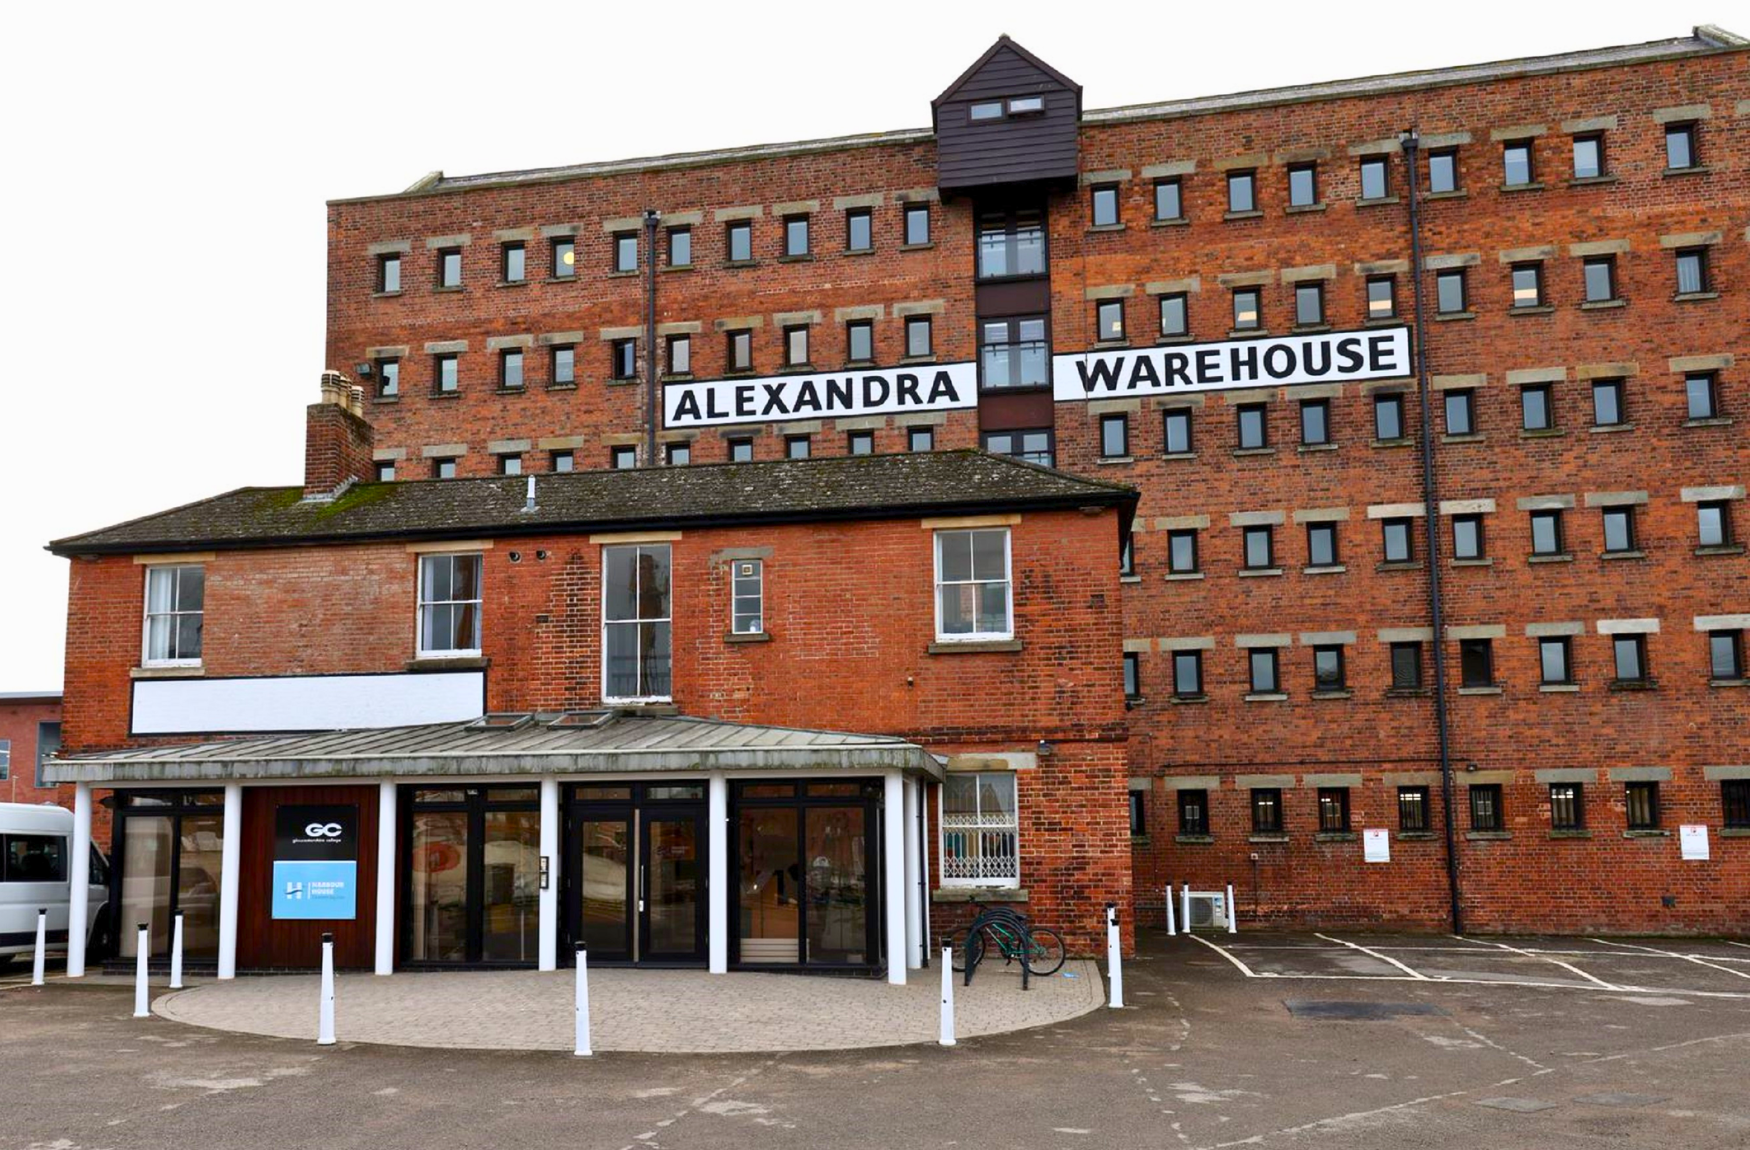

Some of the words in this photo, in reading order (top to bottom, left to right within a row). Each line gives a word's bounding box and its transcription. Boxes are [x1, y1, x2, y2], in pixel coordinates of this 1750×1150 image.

[672, 371, 960, 421] ALEXANDRA
[1075, 335, 1397, 391] WAREHOUSE
[305, 822, 342, 837] GC
